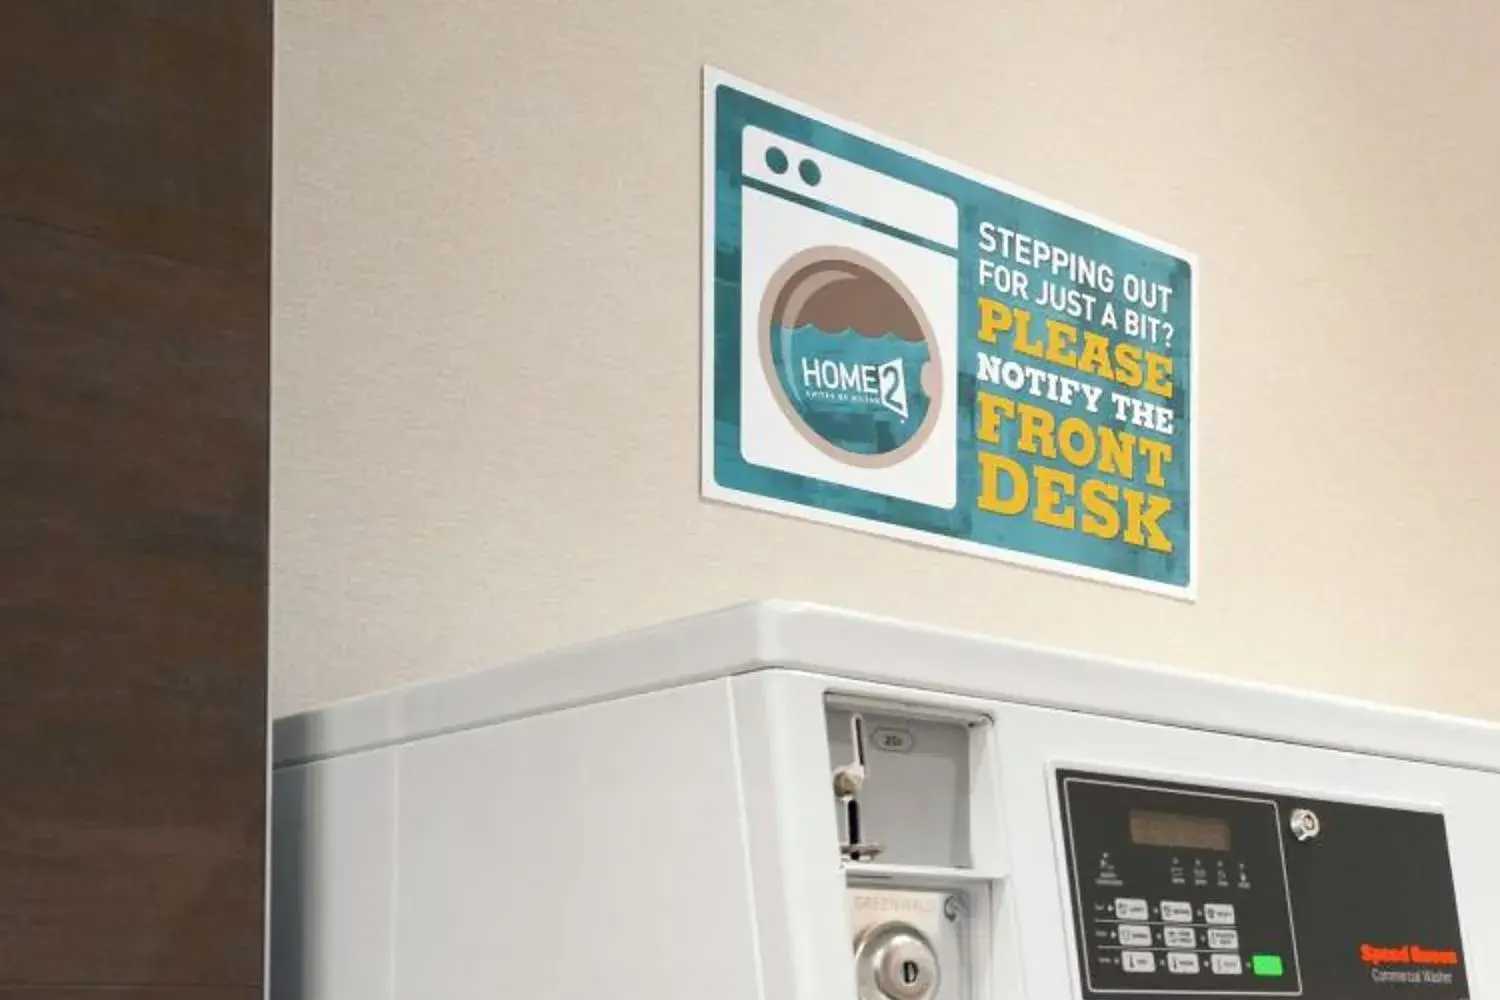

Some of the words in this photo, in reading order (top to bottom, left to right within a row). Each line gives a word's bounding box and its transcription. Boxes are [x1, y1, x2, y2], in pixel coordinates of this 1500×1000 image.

[978, 221, 1115, 294] STEPPING
[1123, 273, 1173, 314] OUT
[978, 259, 1029, 300] FOR
[1035, 280, 1097, 321] JUST
[1101, 302, 1119, 330] A
[1124, 309, 1174, 347] BIT?
[976, 352, 1103, 412] NOTIFY
[1111, 391, 1174, 435] THE
[977, 296, 1174, 398] PLEASE
[977, 391, 1173, 488] FRONT
[977, 450, 1174, 555] DESK
